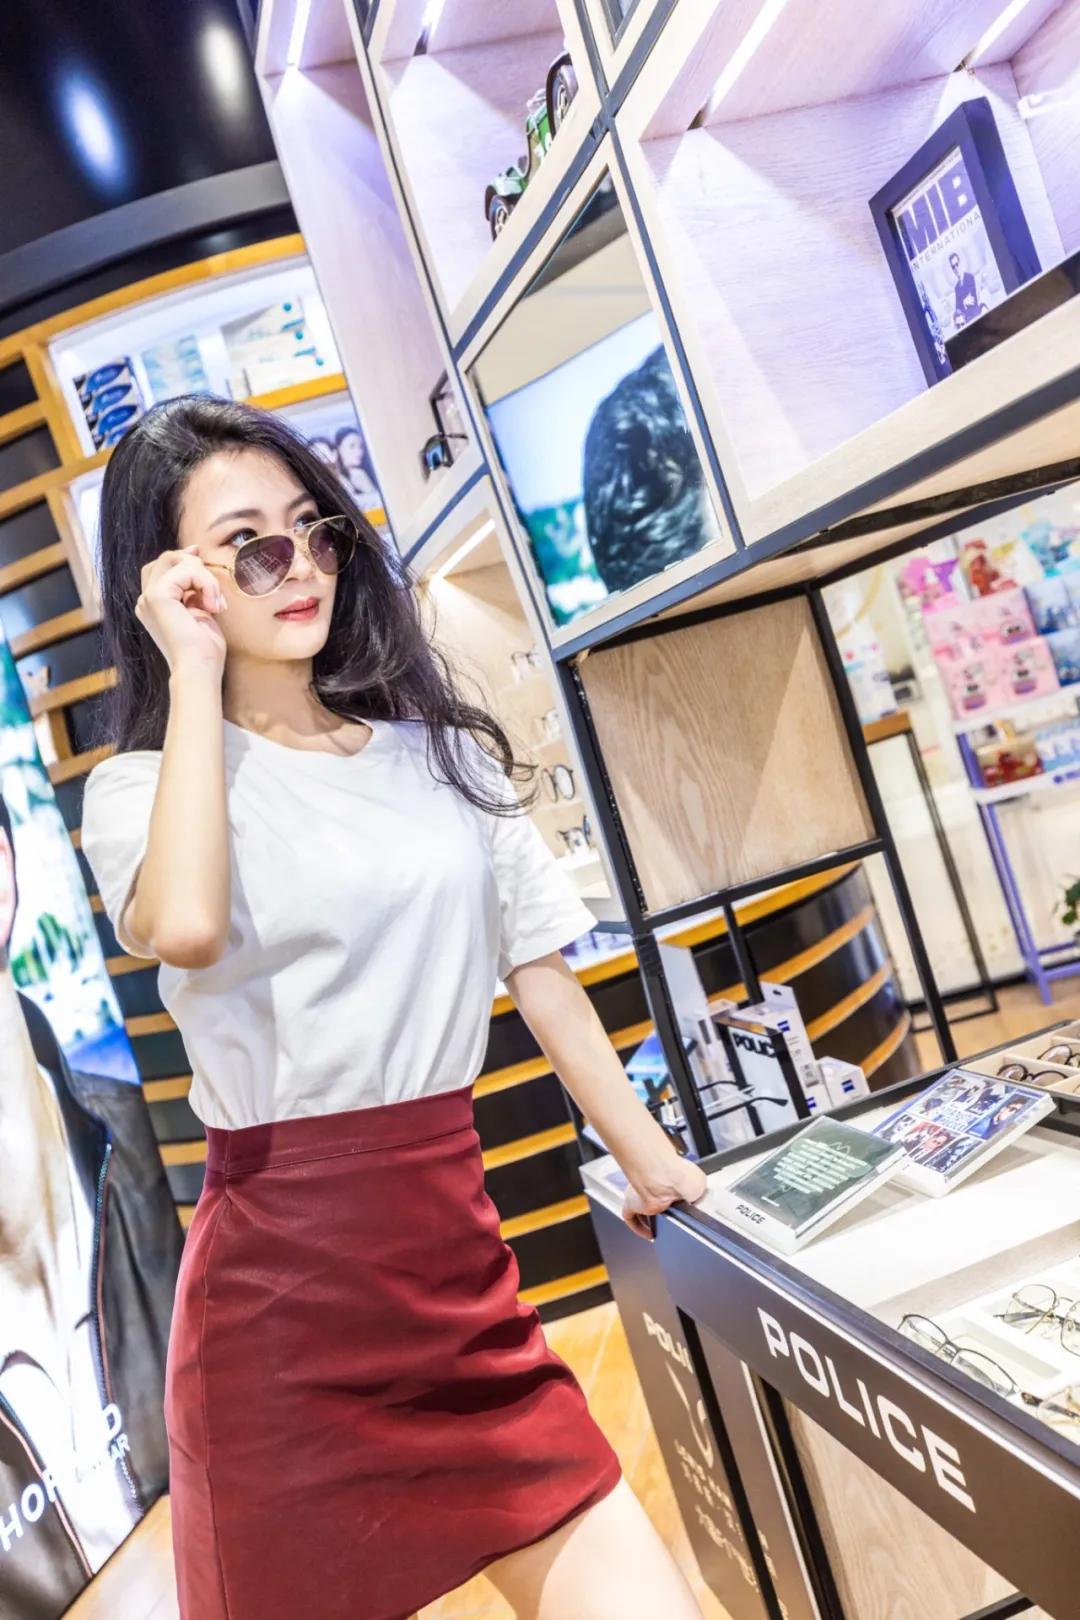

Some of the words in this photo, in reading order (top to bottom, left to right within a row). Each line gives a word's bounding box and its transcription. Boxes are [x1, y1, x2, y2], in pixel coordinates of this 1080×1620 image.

[898, 160, 977, 261] MIB
[912, 211, 980, 270] NTERNATIONA
[732, 1032, 777, 1058] POLIC
[735, 1204, 766, 1225] POLICE
[757, 1307, 976, 1513] POLICE
